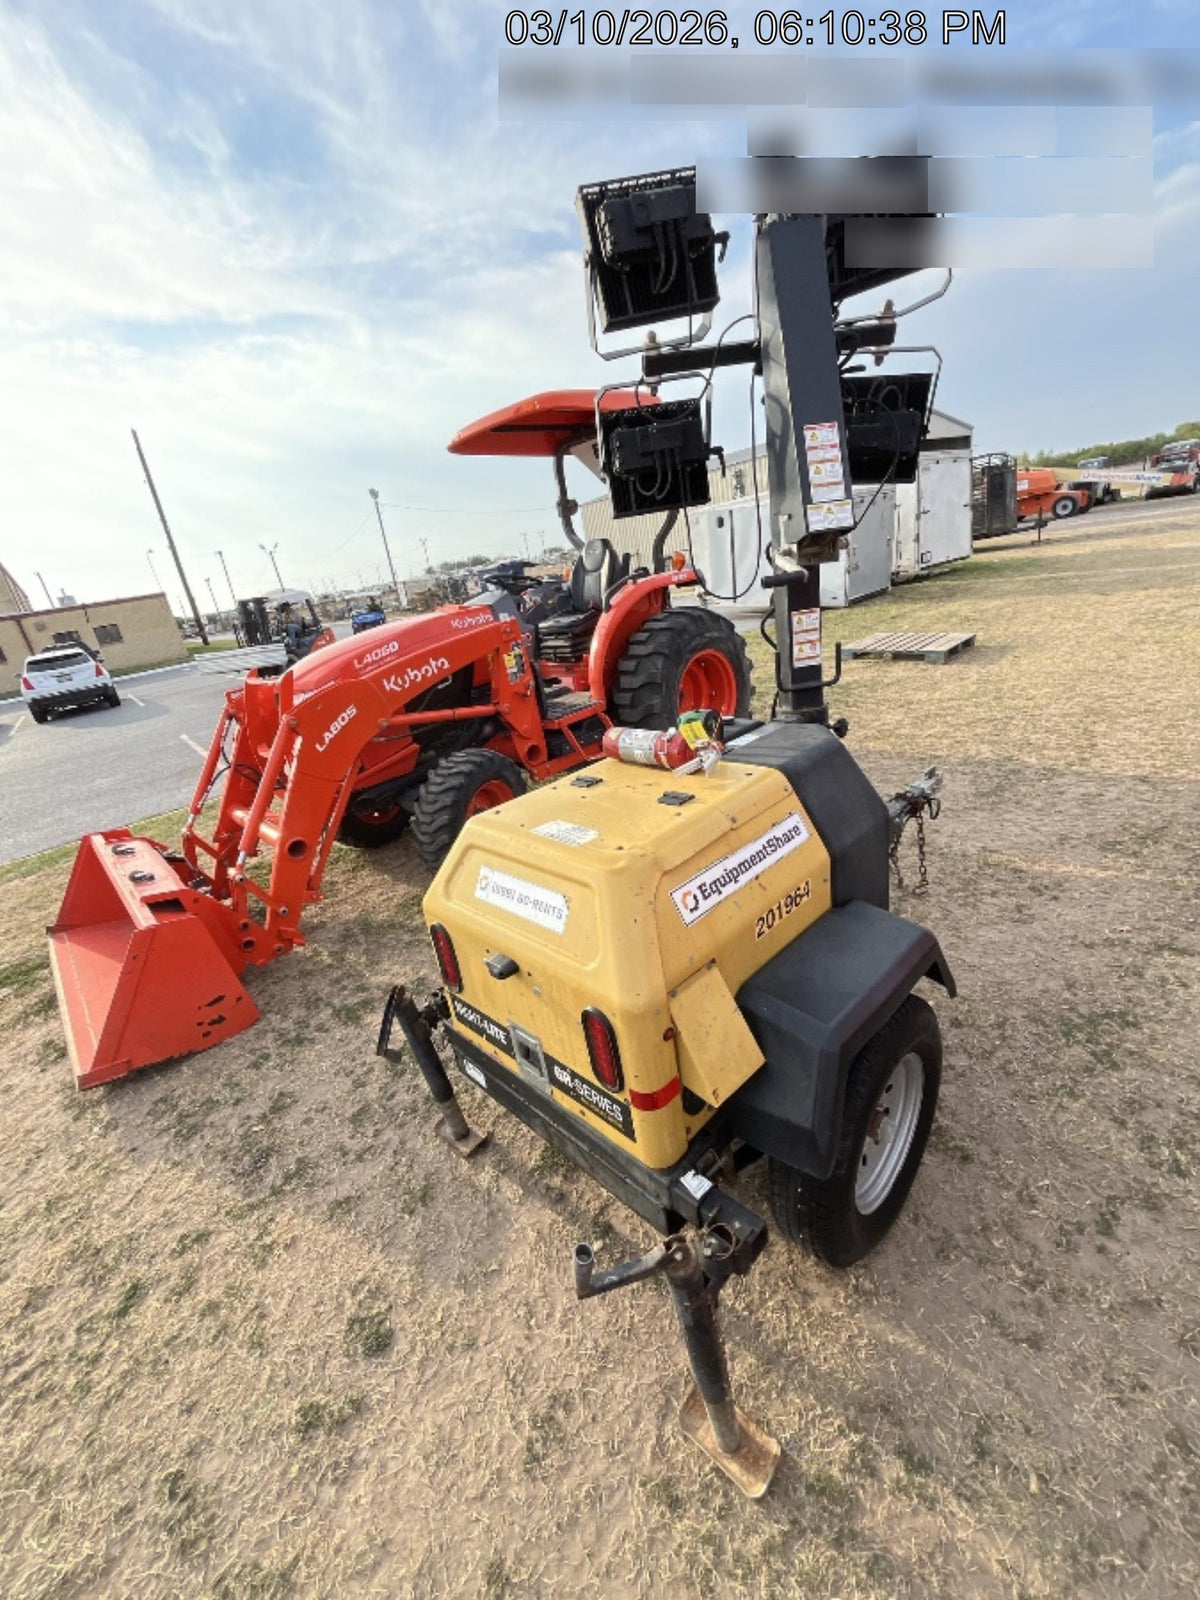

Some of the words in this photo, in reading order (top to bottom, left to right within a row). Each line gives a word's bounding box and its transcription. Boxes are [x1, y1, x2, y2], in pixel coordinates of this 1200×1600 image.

[383, 657, 450, 692] Kubota
[697, 823, 802, 901] EquipmentShare
[756, 879, 812, 939] 201964
